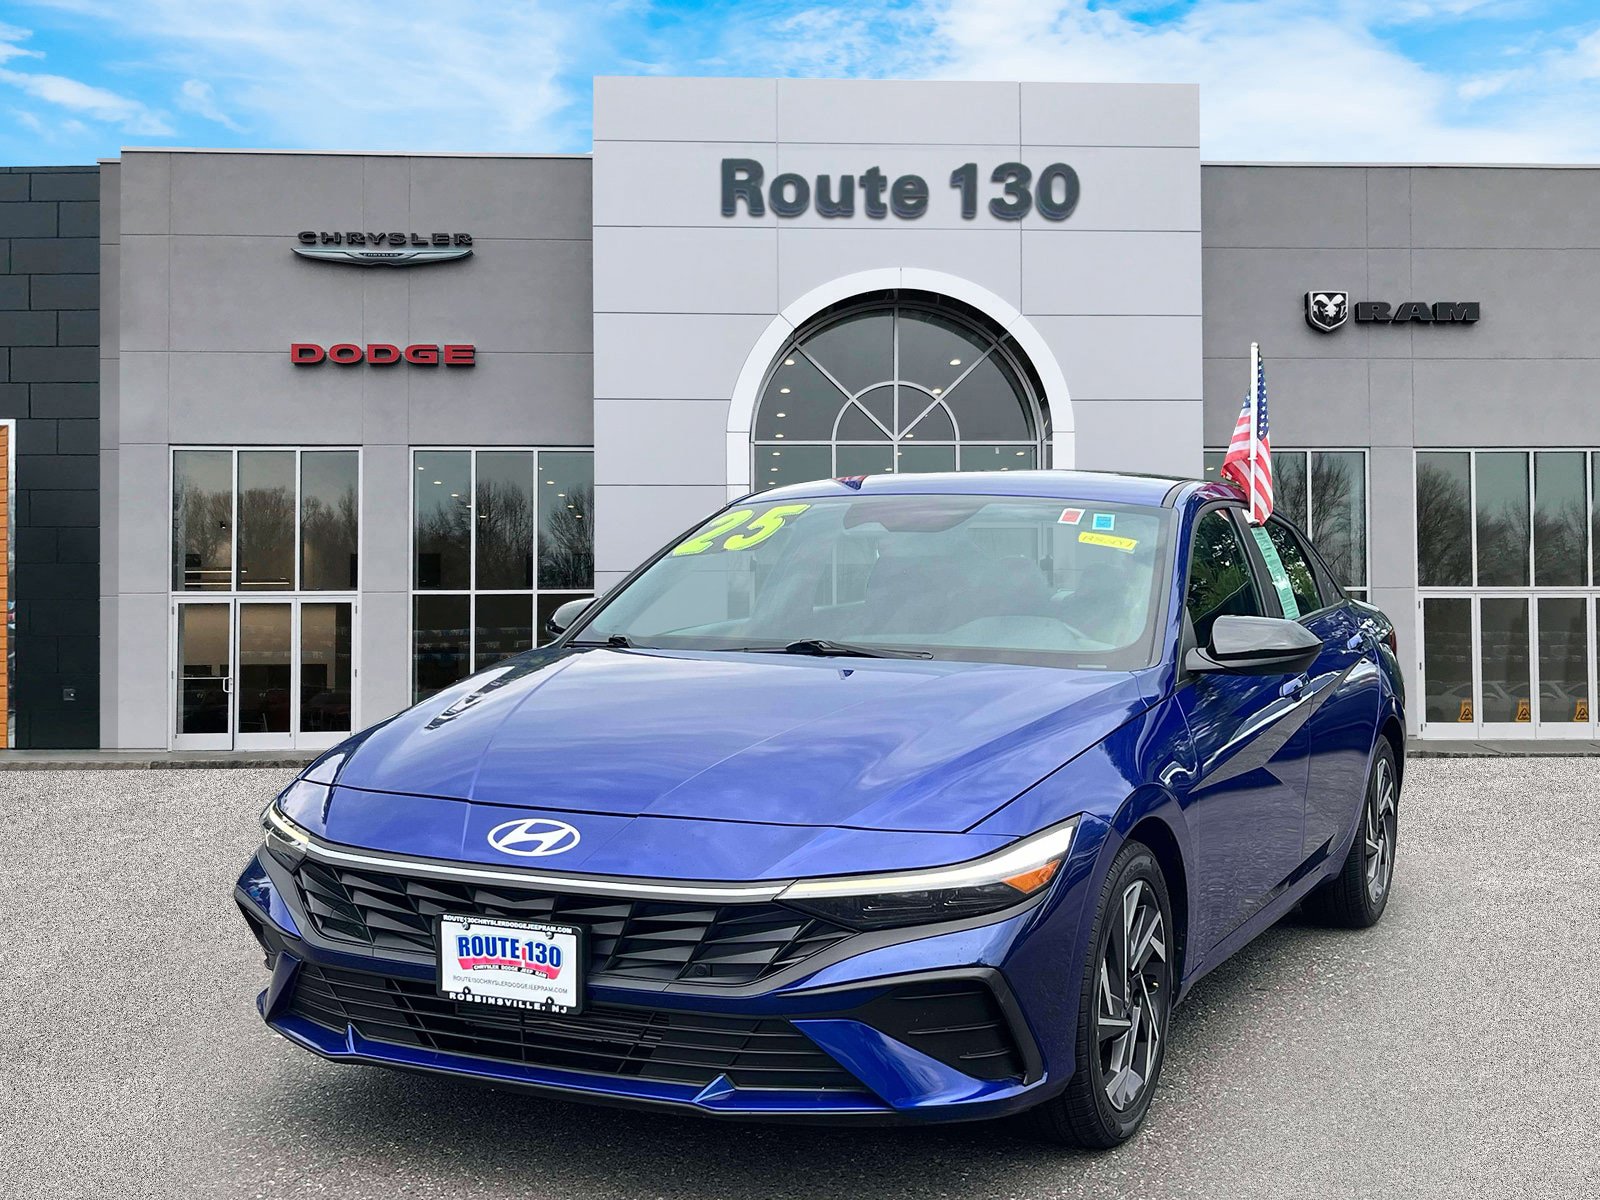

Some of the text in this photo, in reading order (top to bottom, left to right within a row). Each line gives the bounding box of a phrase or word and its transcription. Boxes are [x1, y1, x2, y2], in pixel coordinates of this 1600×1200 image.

[720, 157, 1081, 221] Route 130
[297, 230, 473, 246] CHRYSLER
[1354, 301, 1481, 325] RAM
[290, 343, 476, 366] DODGE
[672, 503, 812, 556] 25
[457, 936, 562, 968] ROUTE 130
[551, 1006, 568, 1014] NJ
